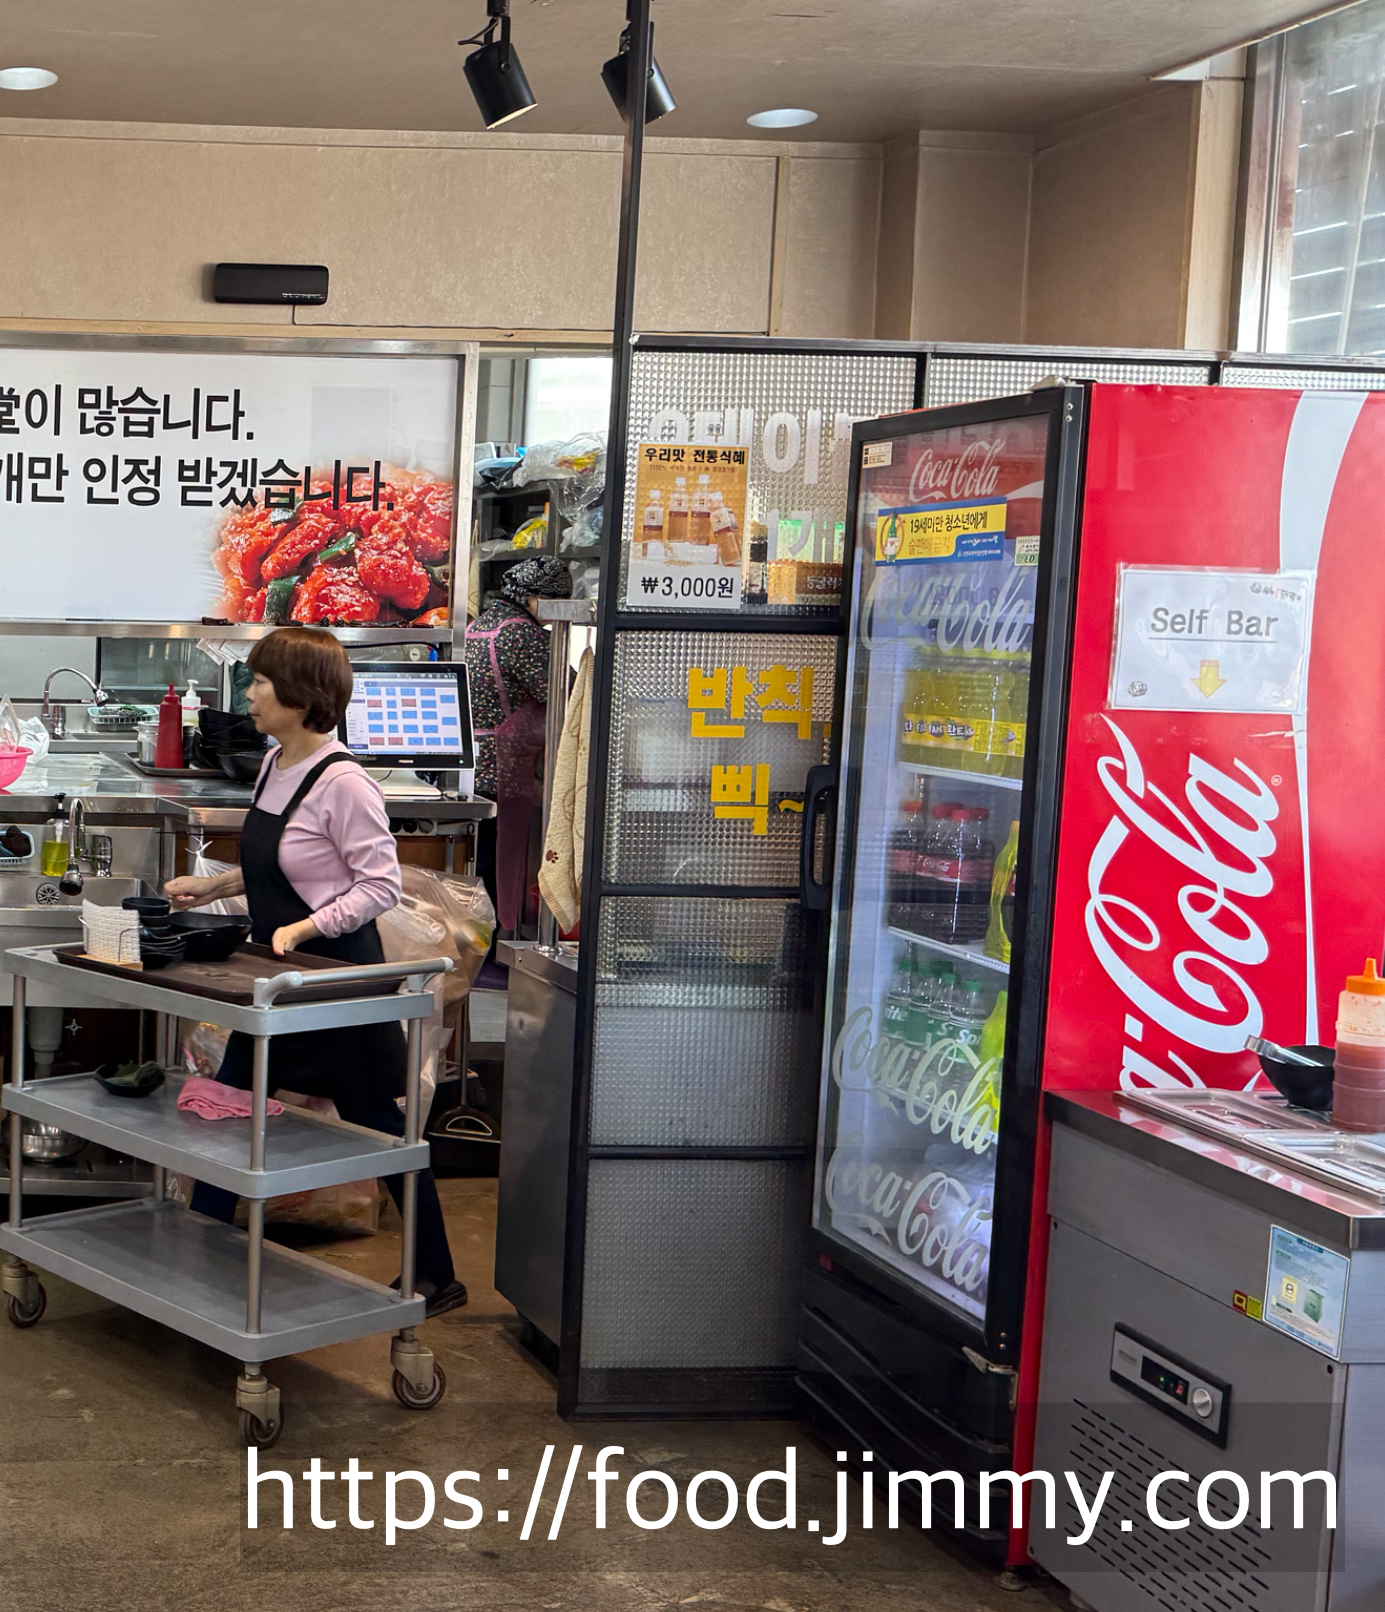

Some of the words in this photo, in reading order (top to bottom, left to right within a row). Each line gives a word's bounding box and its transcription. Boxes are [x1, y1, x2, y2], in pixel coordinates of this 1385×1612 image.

[77, 386, 254, 440] 많습니다.
[644, 447, 685, 463] 우리맛
[693, 449, 745, 465] 전통식혜
[909, 438, 1007, 502] Coca-Cola
[82, 455, 161, 507] 인정
[178, 458, 394, 511] 받겠습니다.
[910, 515, 944, 533] 19세미만
[945, 511, 988, 531] 청소년에게
[1150, 606, 1209, 634] Self
[1226, 609, 1279, 637] Bar
